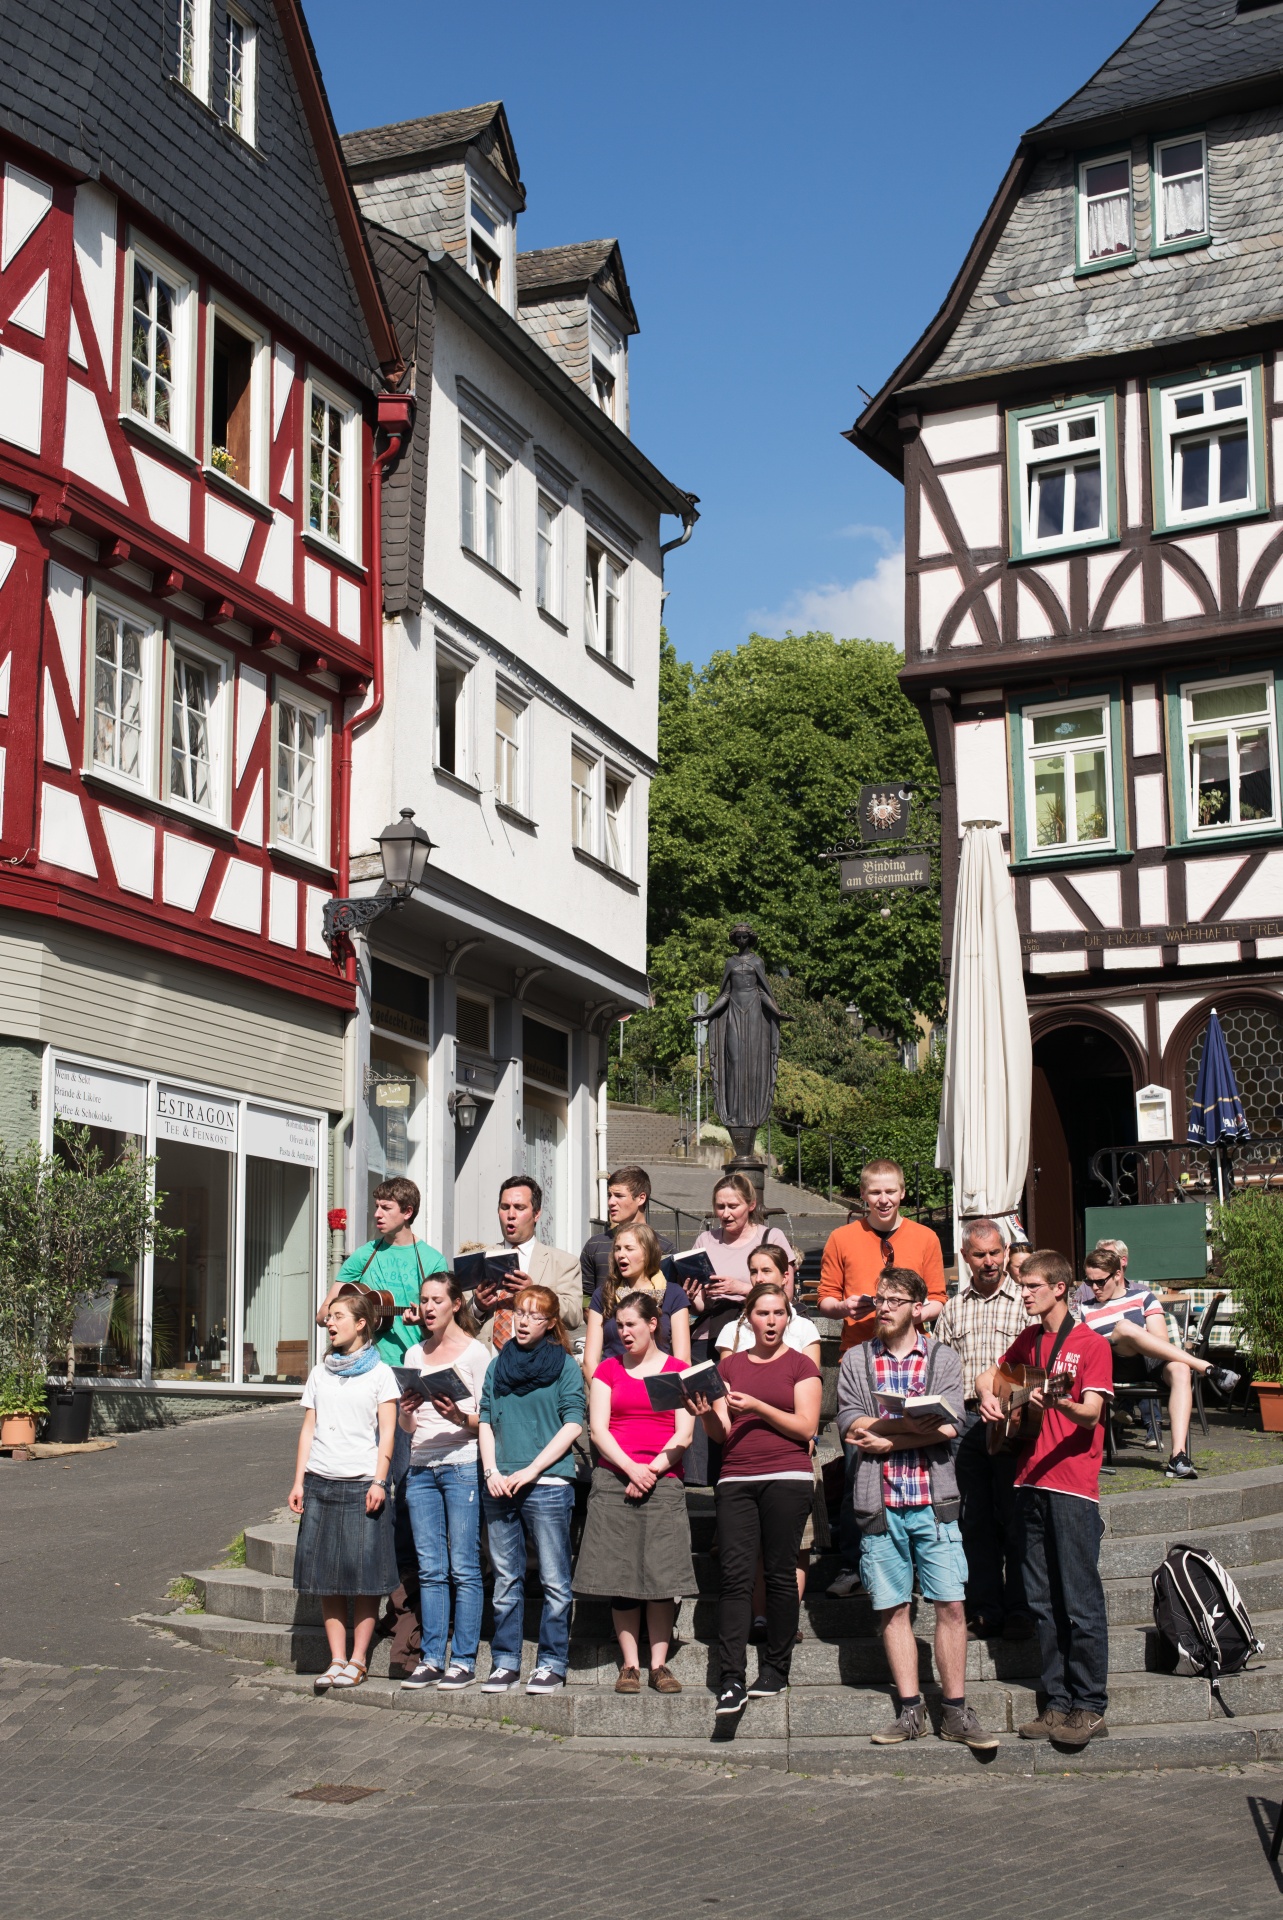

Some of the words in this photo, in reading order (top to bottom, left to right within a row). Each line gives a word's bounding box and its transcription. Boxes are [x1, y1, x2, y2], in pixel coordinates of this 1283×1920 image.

[862, 860, 906, 873] Binding
[846, 877, 862, 887] am
[865, 869, 923, 885] Eisenmarkt
[1108, 931, 1156, 946] EINZIGE
[1165, 925, 1240, 942] WAHRHAFTE
[375, 1009, 408, 1031] gedeckte
[409, 1018, 427, 1038] Tisch
[55, 1069, 70, 1081] Wein
[71, 1073, 77, 1082] &
[55, 1086, 75, 1099] Brände
[76, 1090, 82, 1100] &
[55, 1102, 74, 1115] Kaffee
[75, 1107, 80, 1117] &
[157, 1091, 235, 1127] ESTRAGON
[183, 1125, 189, 1137] &
[1050, 1360, 1078, 1378] IMITS
